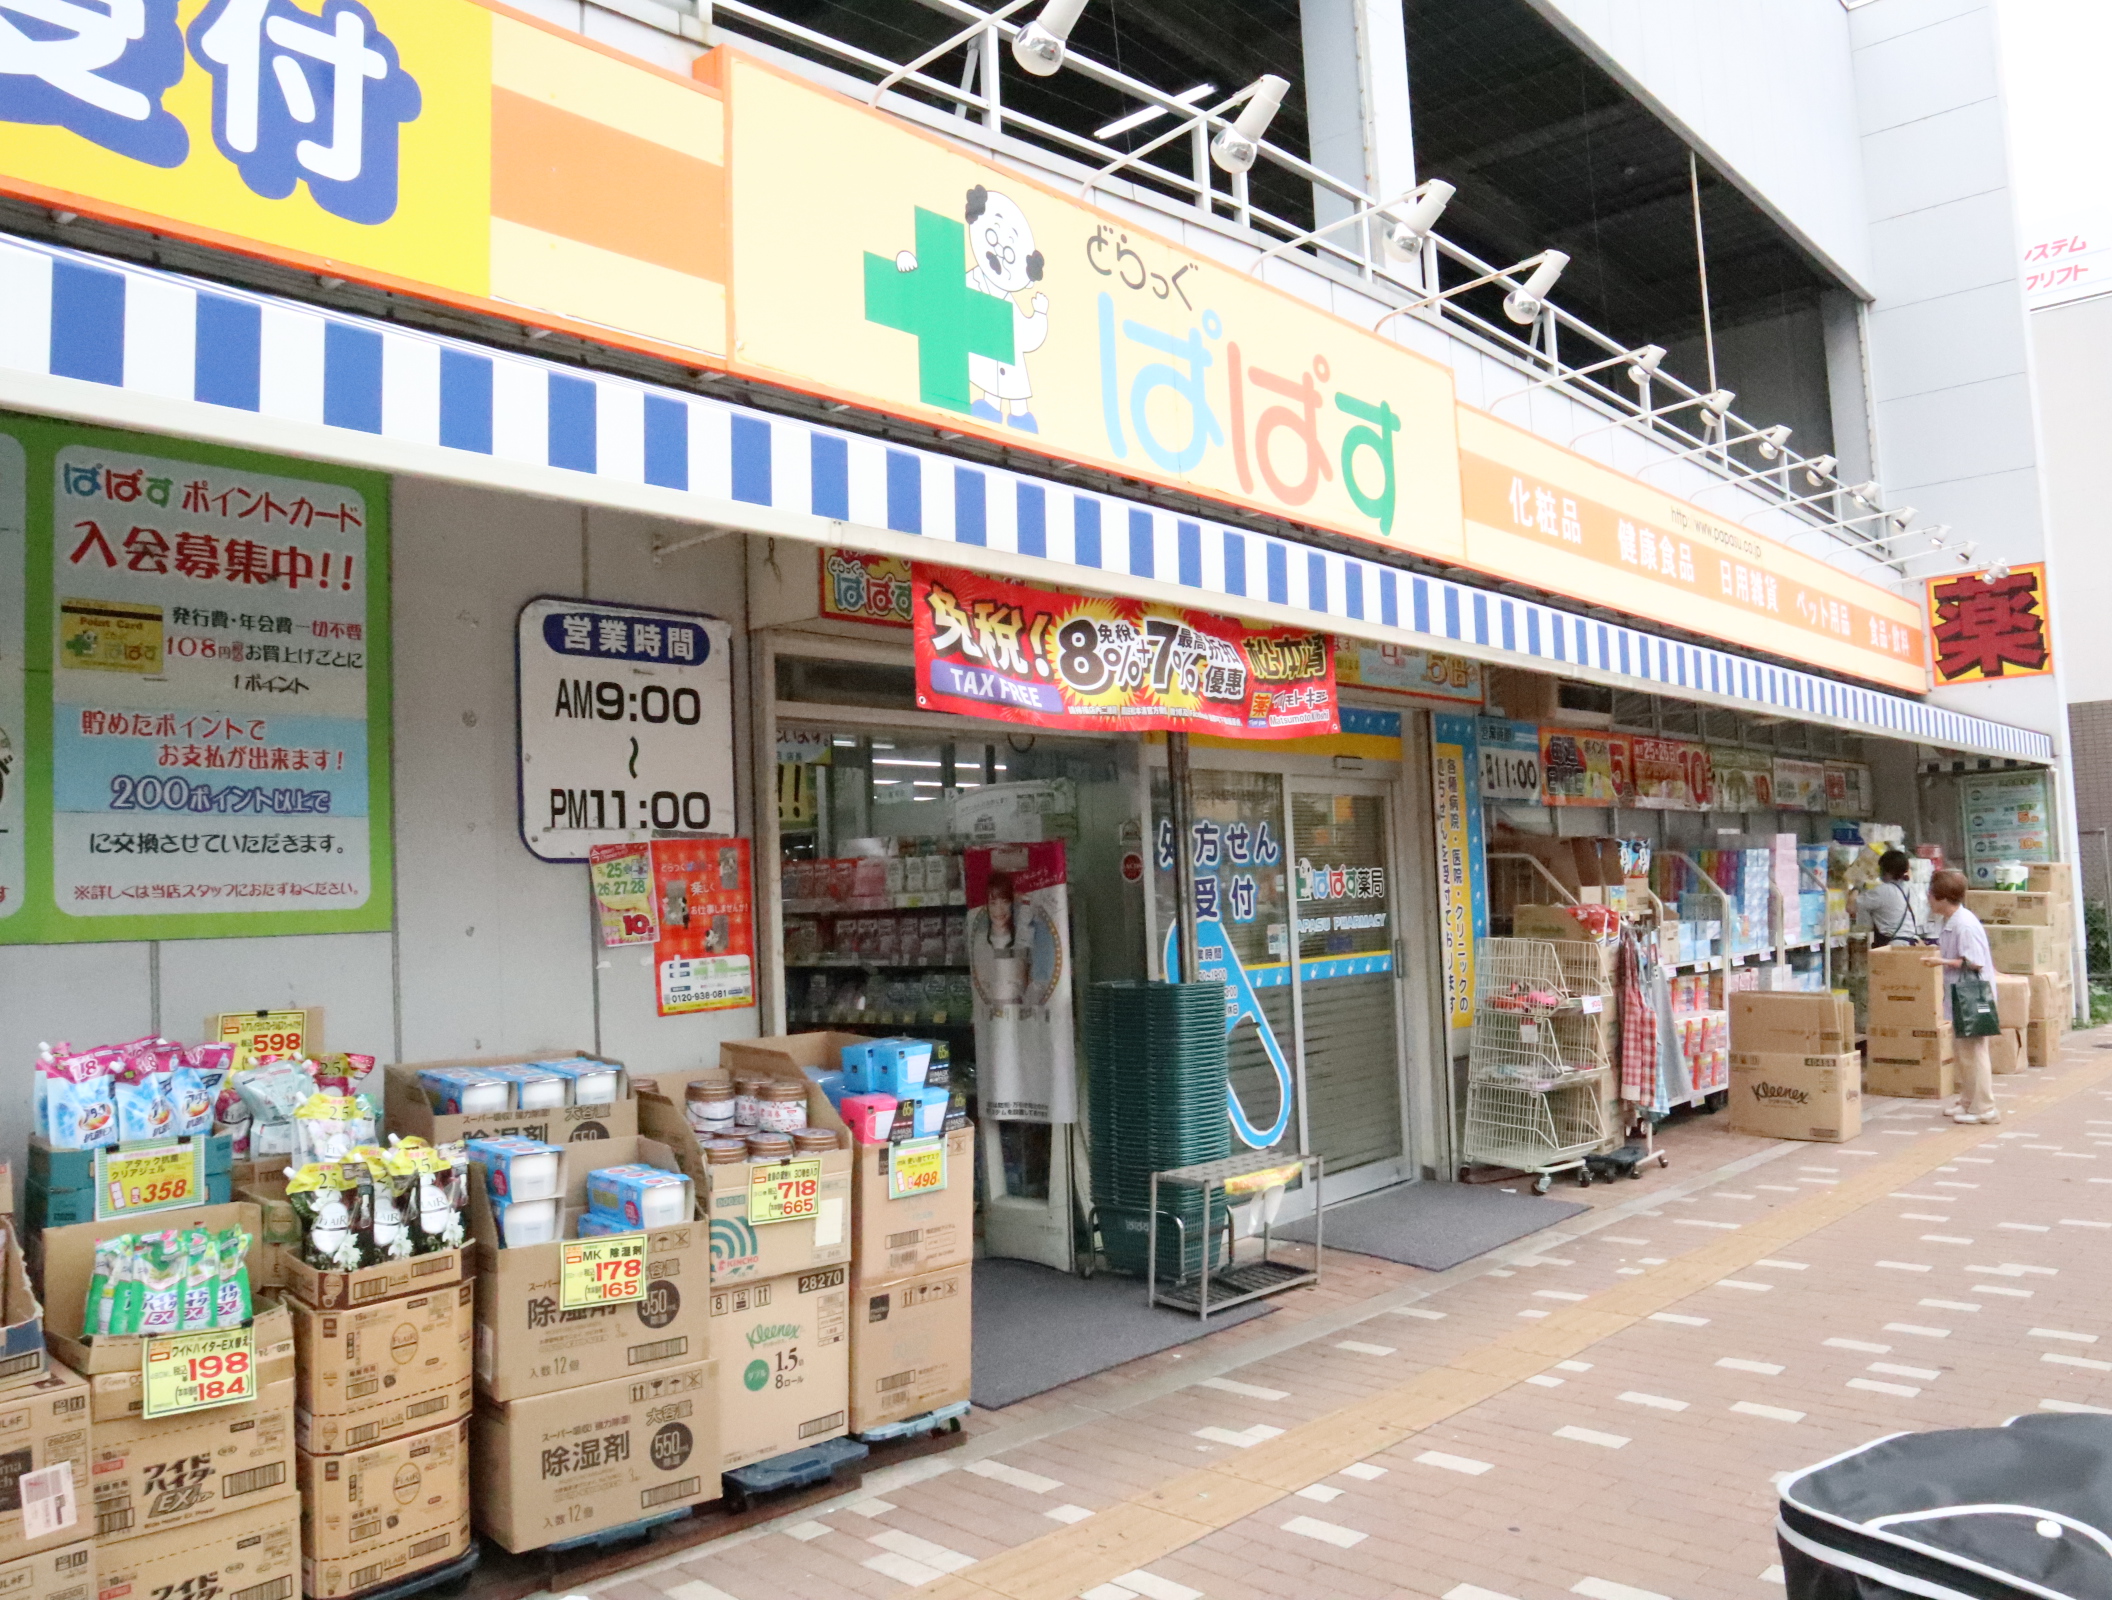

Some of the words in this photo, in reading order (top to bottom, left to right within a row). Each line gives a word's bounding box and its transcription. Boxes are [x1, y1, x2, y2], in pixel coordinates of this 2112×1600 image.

[1087, 225, 1198, 310] どらっぐ
[1098, 291, 1401, 536] ぱぱす
[63, 462, 174, 508] ぱぱす
[181, 479, 363, 533] ポイントカード
[69, 520, 354, 592] 入会募集中!!
[1509, 476, 1582, 545] 化粧品
[1617, 518, 1695, 583] 健康食品
[1720, 559, 1779, 613] 日用雑貨
[1796, 590, 1850, 636] ペット用品
[1868, 615, 1910, 657] 食品・飲料
[80, 616, 112, 631] Point
[116, 620, 144, 632] Card
[1932, 568, 2050, 682] 薬
[562, 613, 696, 661] 営業時間
[233, 674, 310, 695] 1ポイント
[950, 667, 995, 698] TAX
[998, 677, 1043, 708] FREE
[1205, 664, 1244, 696] 優惠
[554, 677, 701, 727] AM9:00
[81, 710, 266, 741] 貯めたポイントで
[158, 744, 344, 771] お支払が出来ます!
[109, 774, 331, 814] 200ポイント以上で
[549, 787, 712, 831] PM11:00
[89, 832, 344, 855] に交換させていただきます。
[690, 881, 715, 896] 楽しく
[1312, 864, 1384, 899] ぱぱす薬局
[1195, 875, 1256, 920] 受付
[1333, 912, 1387, 931] PHARMACY
[253, 1032, 301, 1053] 598
[320, 1061, 342, 1076] 2.5
[1751, 1081, 1809, 1105] Kleenex
[111, 1165, 166, 1181] クリアジェル
[913, 1170, 938, 1188] 498
[142, 1178, 187, 1203] 358
[777, 1179, 817, 1199] 718
[420, 1196, 448, 1208] LAIR
[783, 1198, 814, 1215] 665
[375, 1212, 400, 1223] LAIR
[582, 1250, 602, 1262] MK
[609, 1245, 643, 1258] 除湿剤
[595, 1258, 642, 1282] 178
[646, 1258, 681, 1280] 容量
[602, 1280, 639, 1299] 165
[800, 1271, 842, 1293] 28270
[714, 1297, 723, 1310] 8
[736, 1291, 746, 1301] 12
[149, 1312, 173, 1325] EX
[745, 1323, 801, 1349] Kleenex
[188, 1351, 249, 1382] 198
[198, 1376, 245, 1401] 184
[645, 1399, 692, 1427] 大容量
[541, 1429, 630, 1481] 除湿剤
[654, 1430, 680, 1460] 550
[143, 1452, 211, 1480] ワイド
[143, 1467, 217, 1496] ハイター
[157, 1489, 191, 1512] EX
[151, 1570, 219, 1597] ワイド
